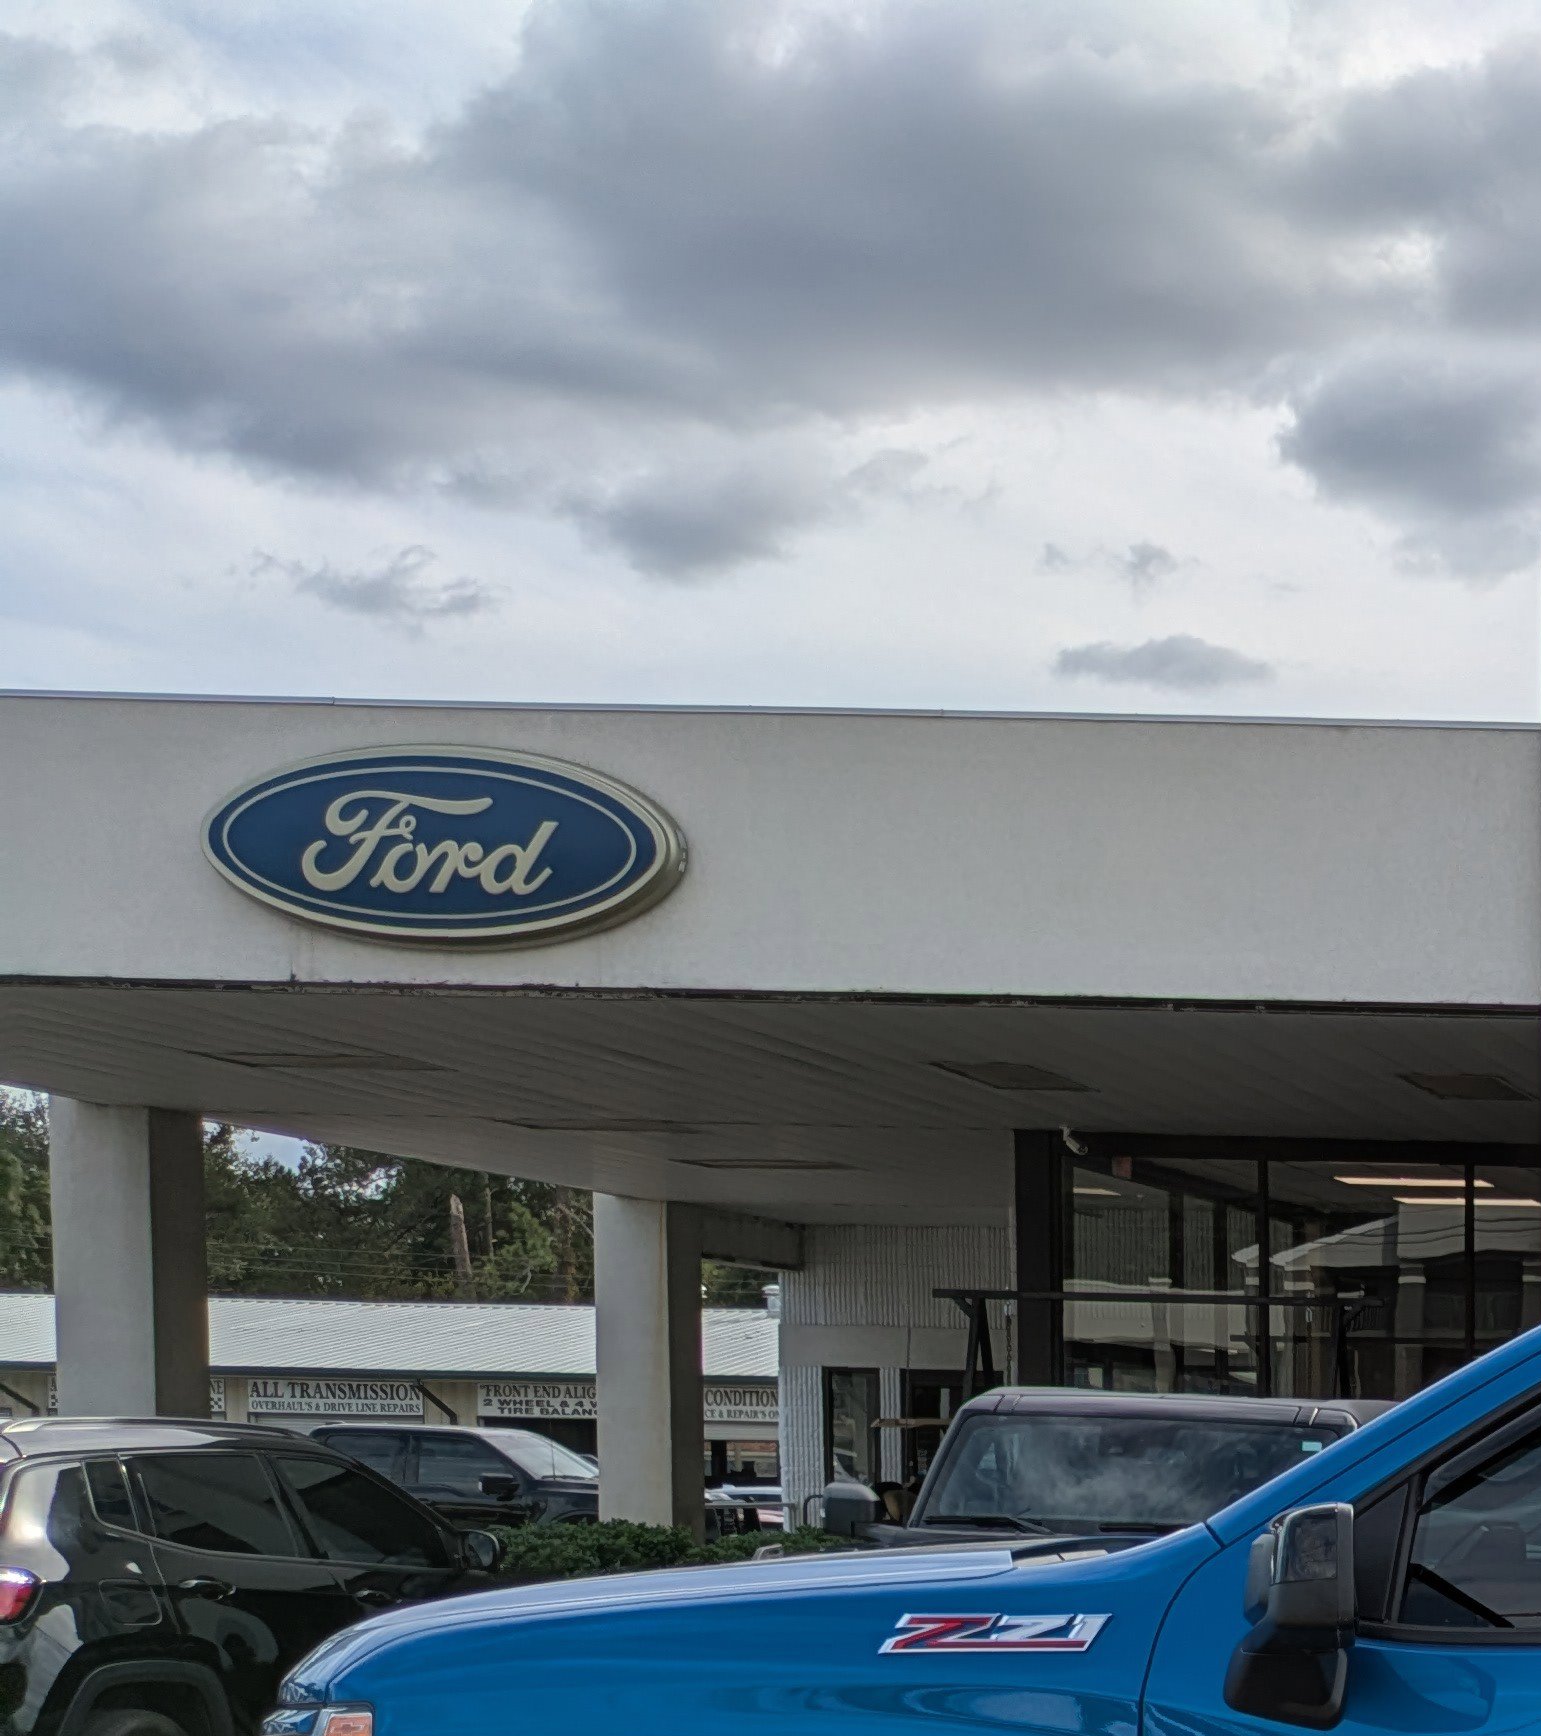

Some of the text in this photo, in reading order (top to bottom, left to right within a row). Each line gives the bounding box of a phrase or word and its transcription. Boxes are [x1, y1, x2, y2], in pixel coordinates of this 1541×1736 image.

[301, 789, 559, 896] Ford
[250, 1381, 420, 1401] ALL TRANSMISSION
[534, 1385, 561, 1399] END
[705, 1389, 779, 1407] CONDITION
[323, 1402, 354, 1412] DRIVE
[355, 1402, 378, 1413] LINE
[380, 1403, 421, 1413] REPAIRS
[498, 1399, 555, 1407] WHEEL
[575, 1400, 584, 1408] 4
[498, 1406, 535, 1415] TIRE
[877, 1612, 1114, 1655] Z71
